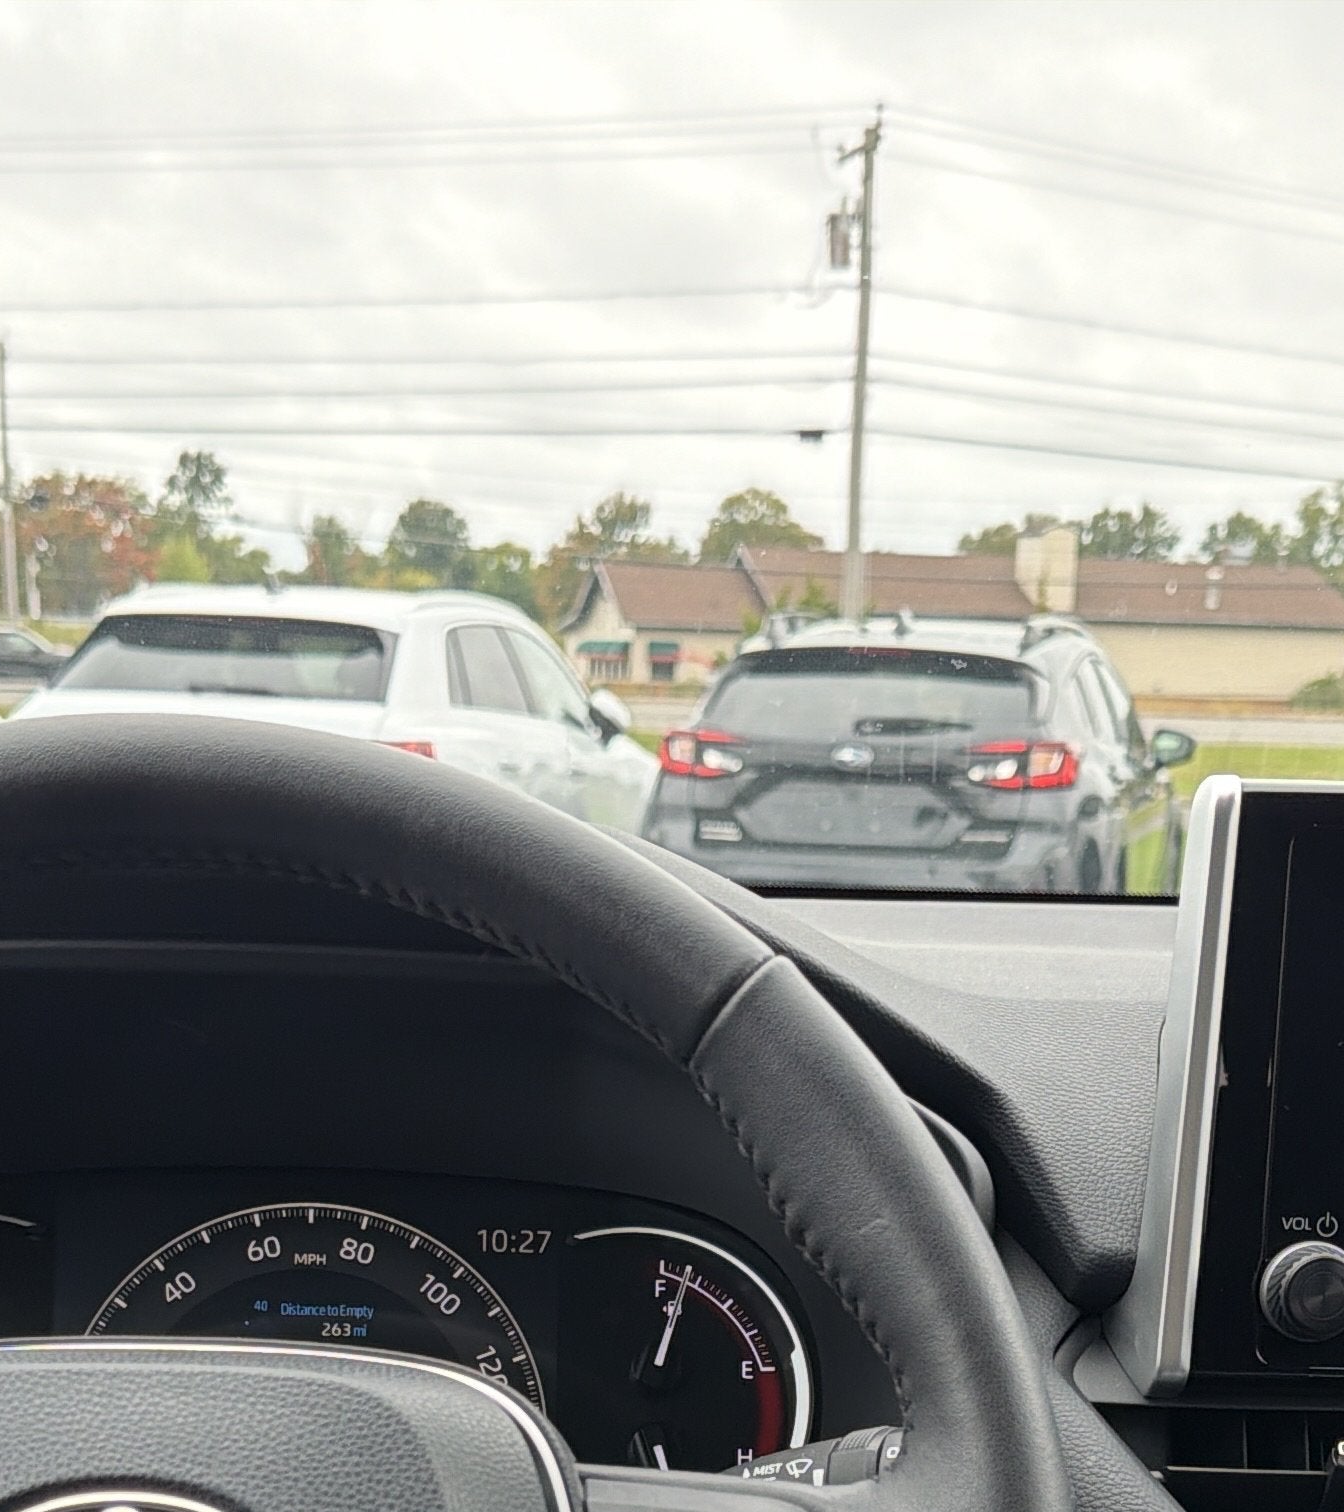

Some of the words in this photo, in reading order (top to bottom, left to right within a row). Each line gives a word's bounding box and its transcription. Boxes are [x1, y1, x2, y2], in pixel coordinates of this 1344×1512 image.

[1281, 1216, 1312, 1231] VOL
[247, 1236, 281, 1262] 60
[339, 1237, 375, 1265] 80
[476, 1228, 552, 1255] 10:27
[293, 1252, 327, 1266] MPH
[164, 1271, 196, 1304] 40
[419, 1273, 461, 1315] 100
[655, 1279, 667, 1299] F
[280, 1302, 326, 1317] Distance
[327, 1304, 339, 1317] to
[340, 1304, 375, 1320] Empty
[320, 1322, 351, 1337] 263
[352, 1324, 367, 1337] mi
[474, 1345, 508, 1386] 120
[742, 1361, 754, 1379] E
[737, 1448, 753, 1466] H
[752, 1462, 784, 1477] MIST
